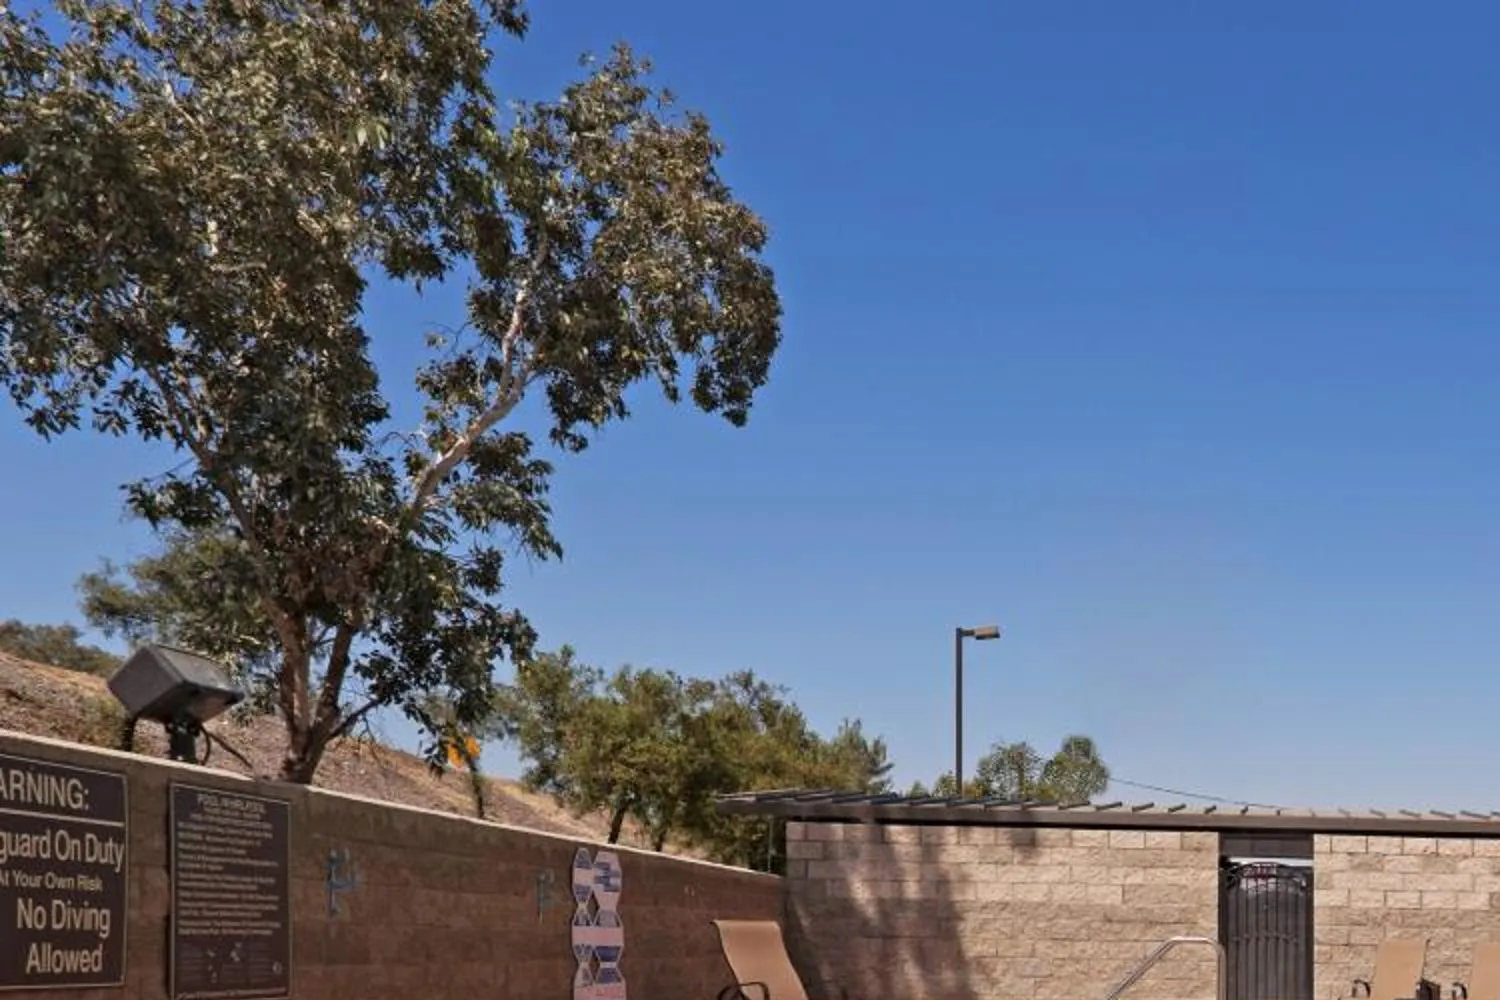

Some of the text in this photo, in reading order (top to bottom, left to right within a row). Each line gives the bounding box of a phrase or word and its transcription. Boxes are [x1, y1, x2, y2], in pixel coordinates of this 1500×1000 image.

[0, 829, 125, 873] guard On Duty
[12, 869, 43, 887] Your
[45, 871, 75, 889] Own
[77, 874, 103, 891] Risk
[17, 898, 111, 938] No Diving
[25, 942, 104, 974] Allowed
